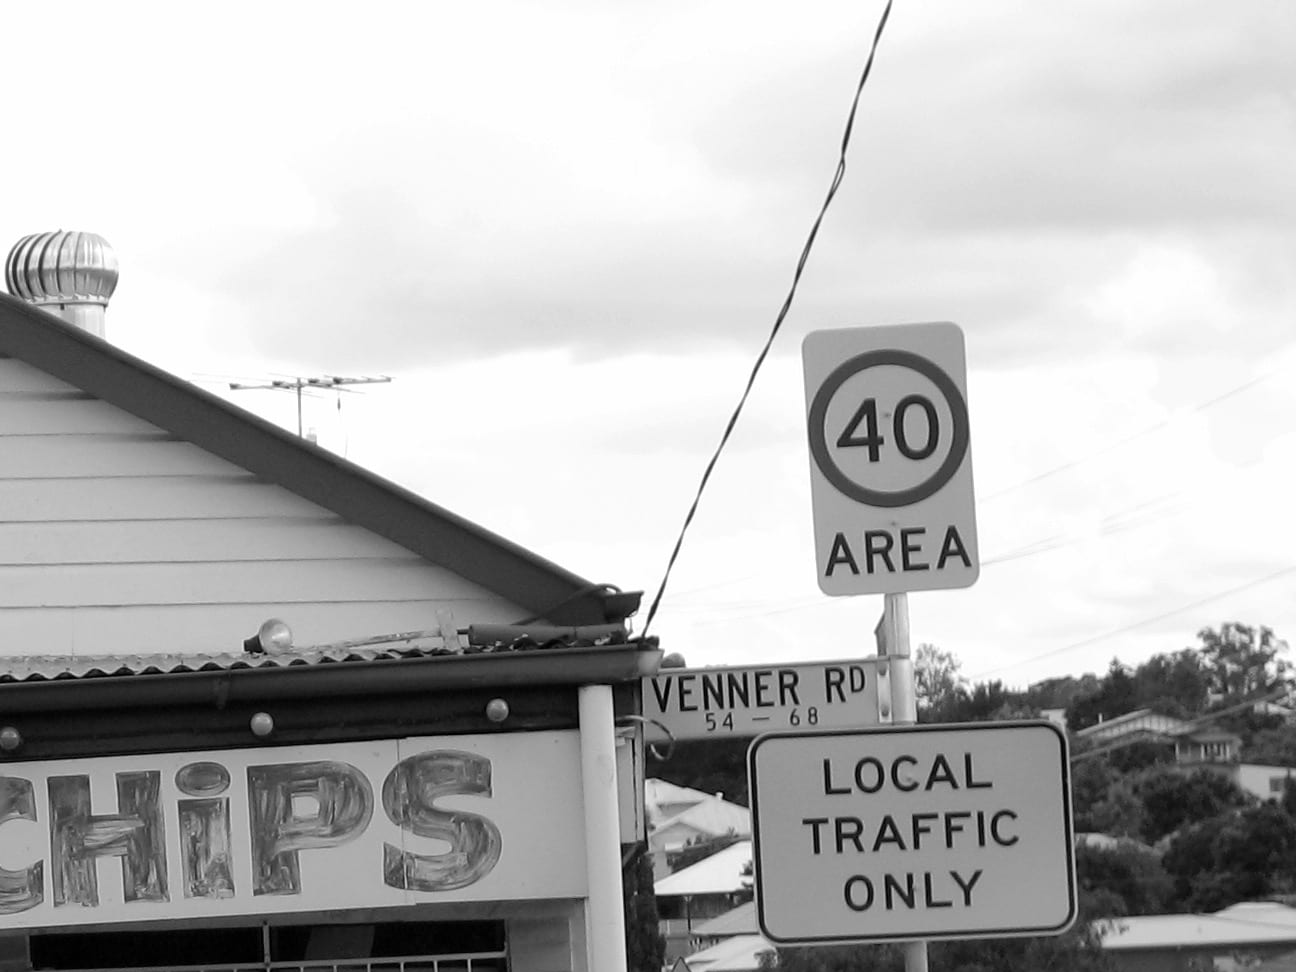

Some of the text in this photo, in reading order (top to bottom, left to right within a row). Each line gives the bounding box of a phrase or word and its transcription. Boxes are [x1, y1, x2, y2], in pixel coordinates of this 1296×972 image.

[836, 394, 941, 463] 40
[824, 525, 974, 578] AREA
[651, 665, 866, 713] VENNER RD
[705, 711, 734, 732] 54
[789, 706, 819, 727] 68
[823, 752, 993, 796] LOCAL
[803, 809, 1021, 856] TRAFFIC
[844, 869, 984, 912] ONLY
